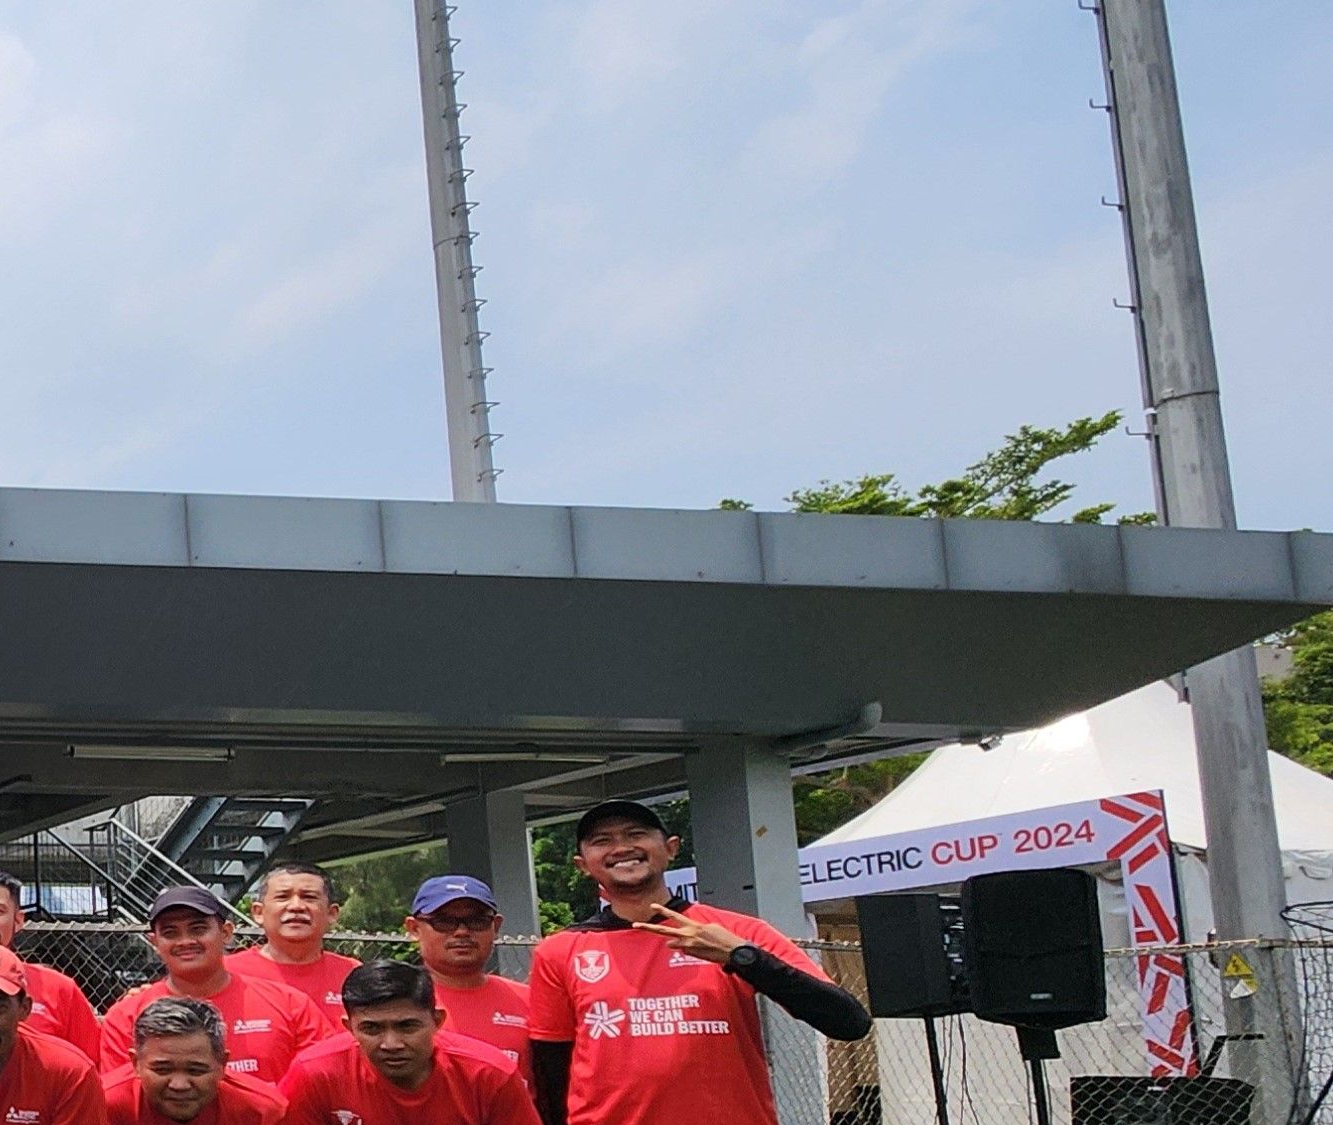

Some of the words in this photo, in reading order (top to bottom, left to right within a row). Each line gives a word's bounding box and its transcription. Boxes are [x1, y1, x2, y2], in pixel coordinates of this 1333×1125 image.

[931, 834, 999, 866] CUP
[1013, 819, 1095, 854] 2024
[627, 994, 700, 1011] TOGETHER
[629, 1010, 651, 1023] WE
[654, 1009, 684, 1022] CAN
[631, 1022, 675, 1036] BUILD
[678, 1021, 730, 1035] BETTER
